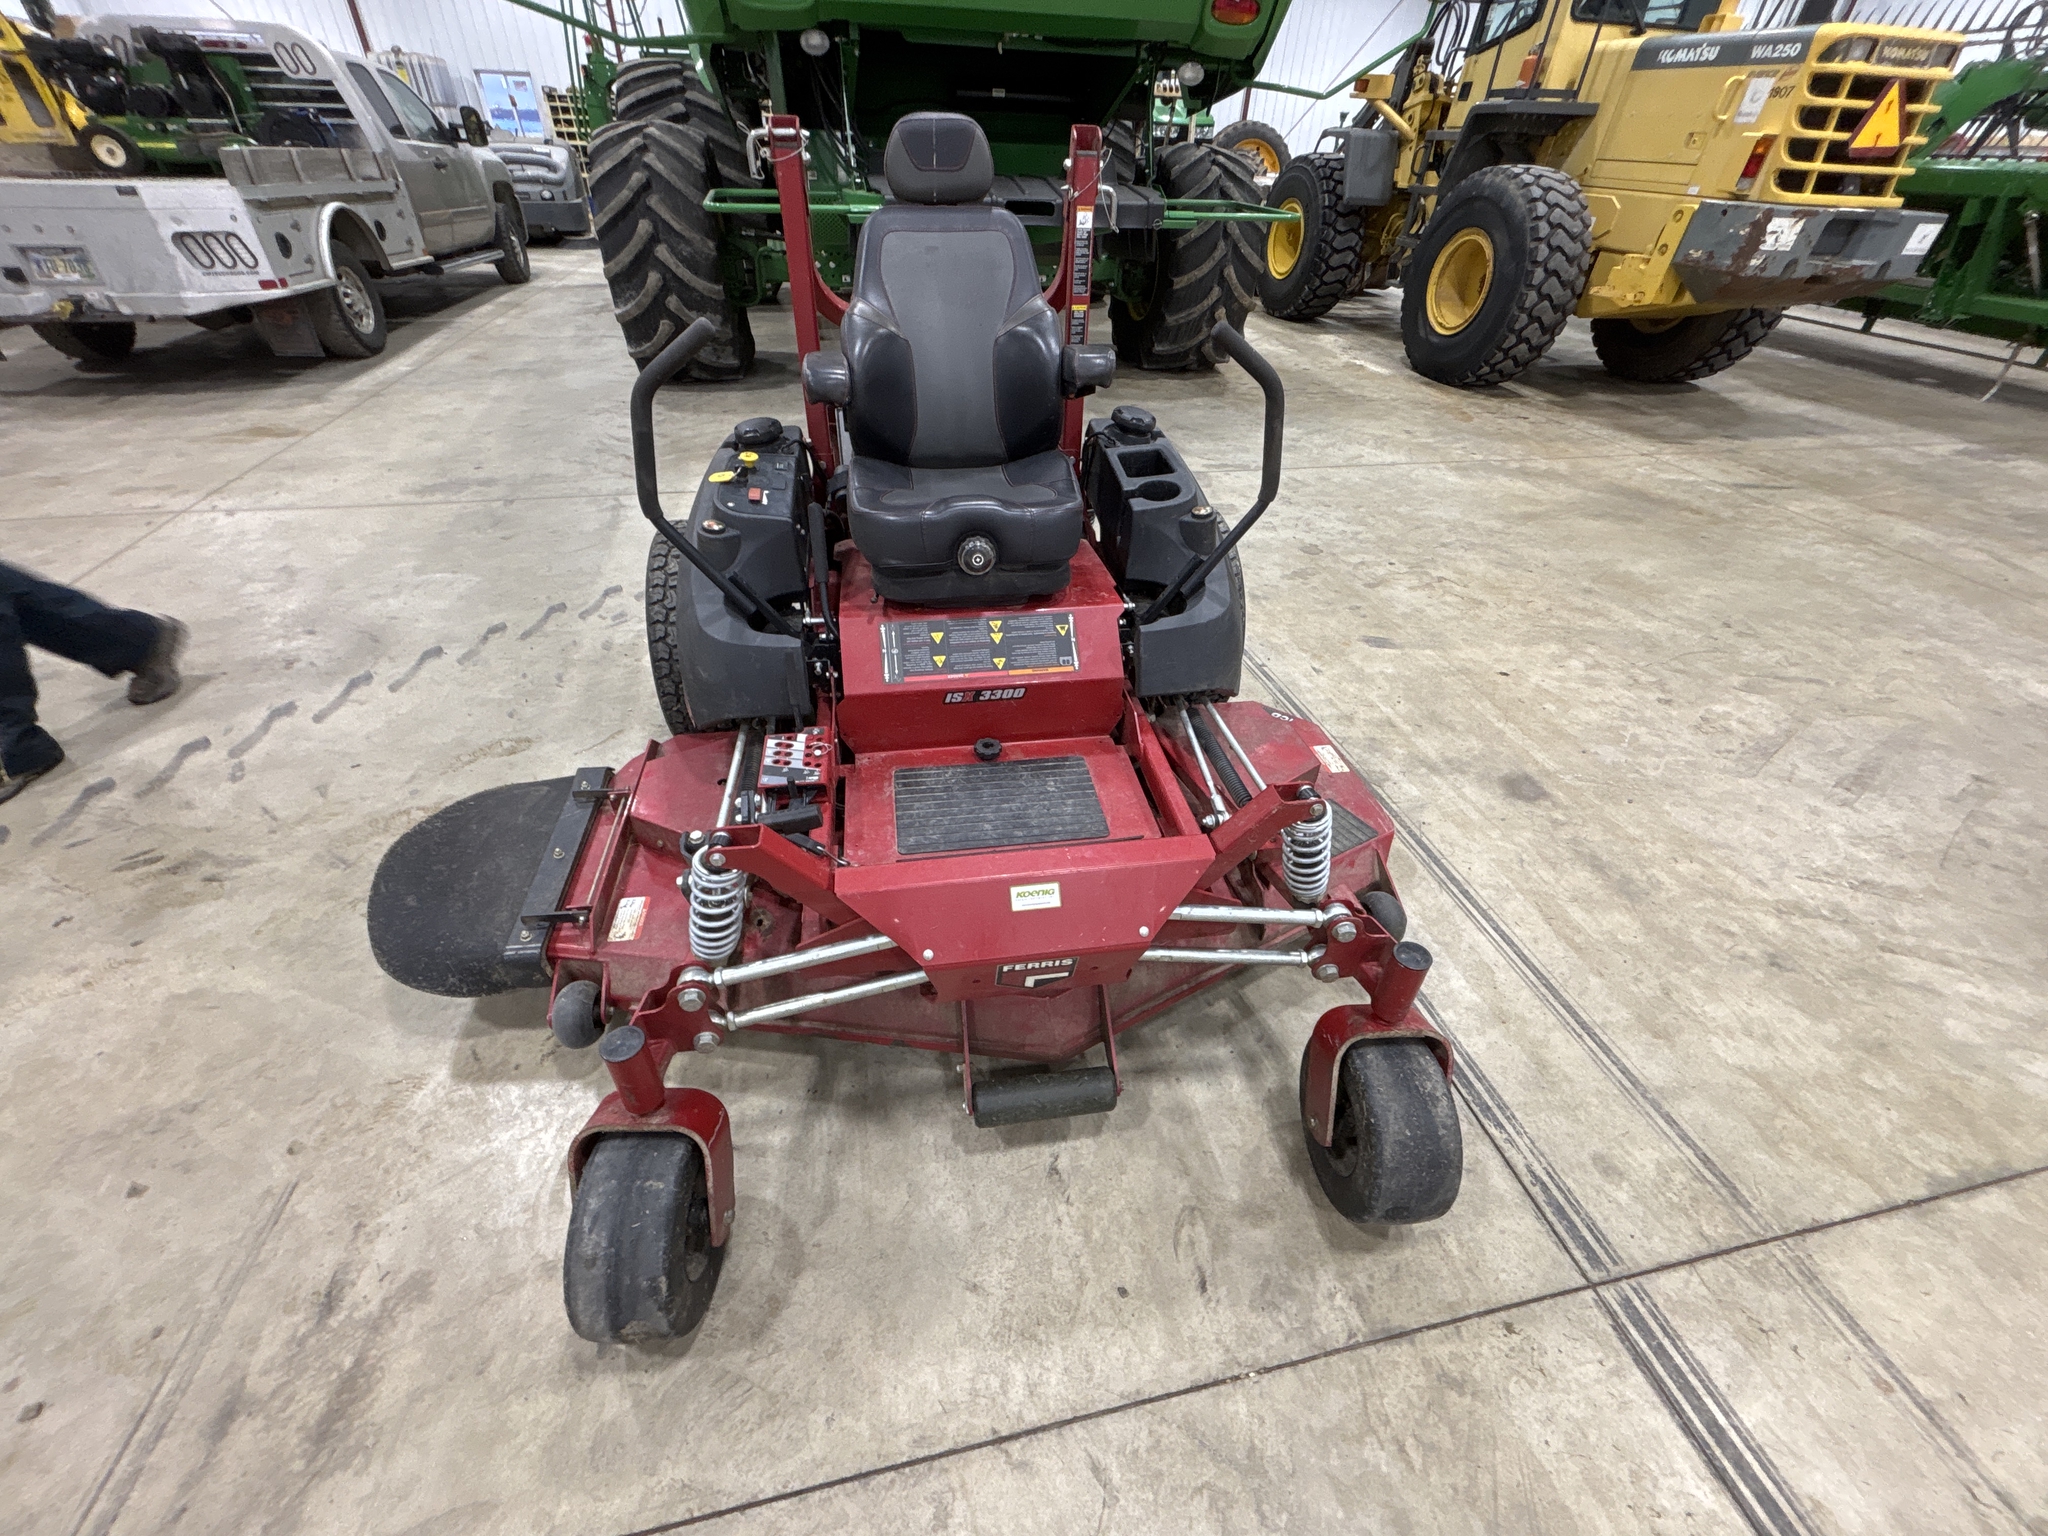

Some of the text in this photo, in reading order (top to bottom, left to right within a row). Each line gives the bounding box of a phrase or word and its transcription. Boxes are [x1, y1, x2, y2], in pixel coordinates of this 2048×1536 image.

[1656, 43, 1802, 63] KOMATSU WA250
[944, 687, 1026, 704] ISX 3300
[1002, 959, 1073, 972] FERRIS
